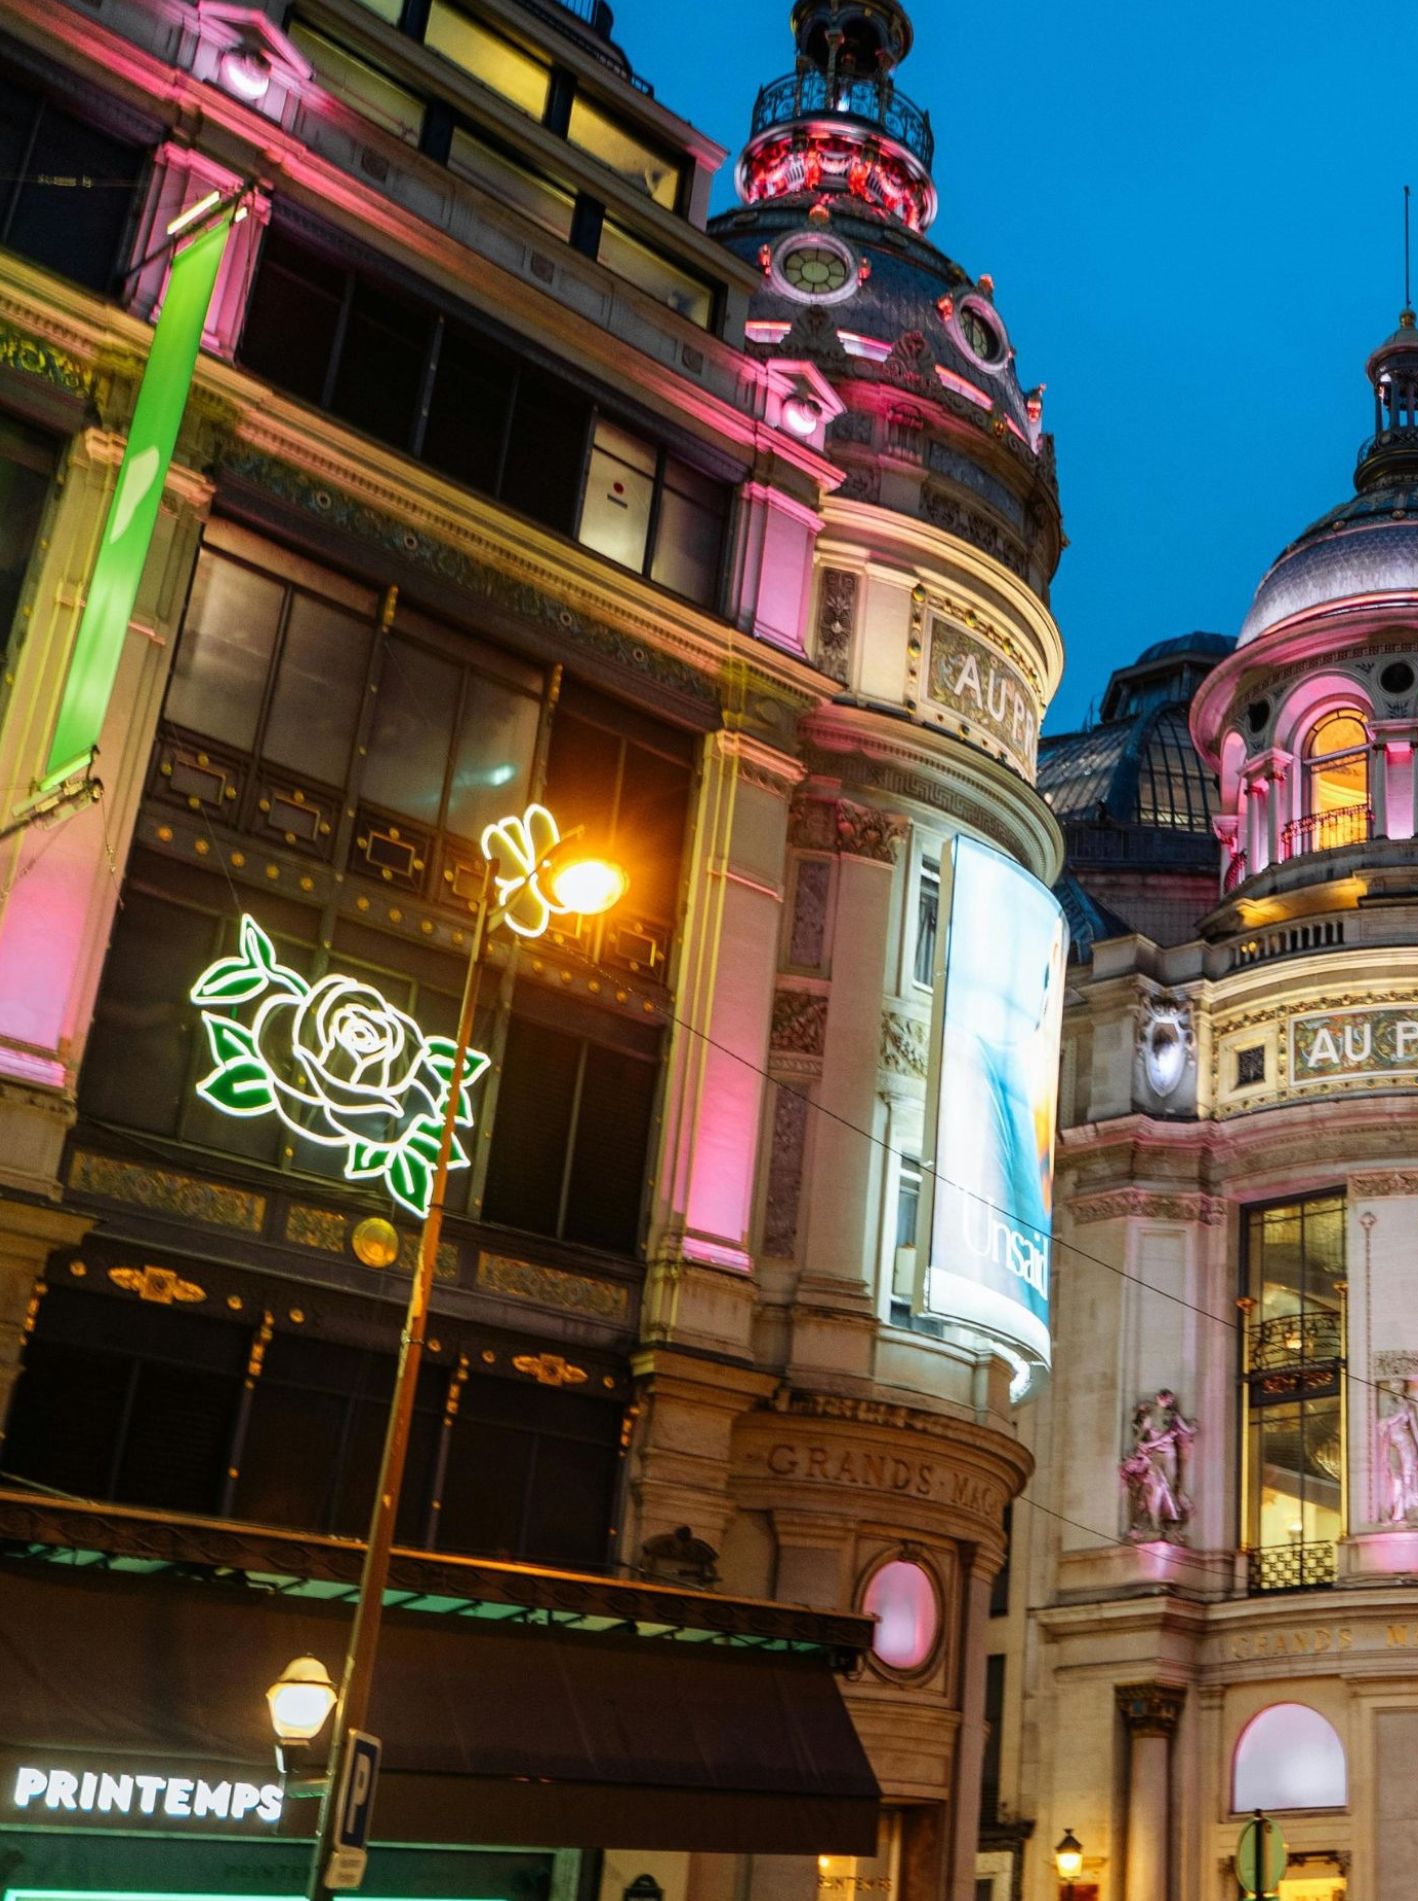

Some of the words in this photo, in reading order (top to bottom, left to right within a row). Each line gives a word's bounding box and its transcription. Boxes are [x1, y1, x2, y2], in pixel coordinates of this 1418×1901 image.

[953, 654, 1007, 723] AU
[1307, 1026, 1372, 1068] AU
[961, 1194, 1050, 1302] Unsaid
[766, 1443, 935, 1496] GRANDS
[1230, 1627, 1353, 1660] GRANDS
[14, 1766, 285, 1822] PRINTEMPS
[345, 1752, 371, 1835] P
